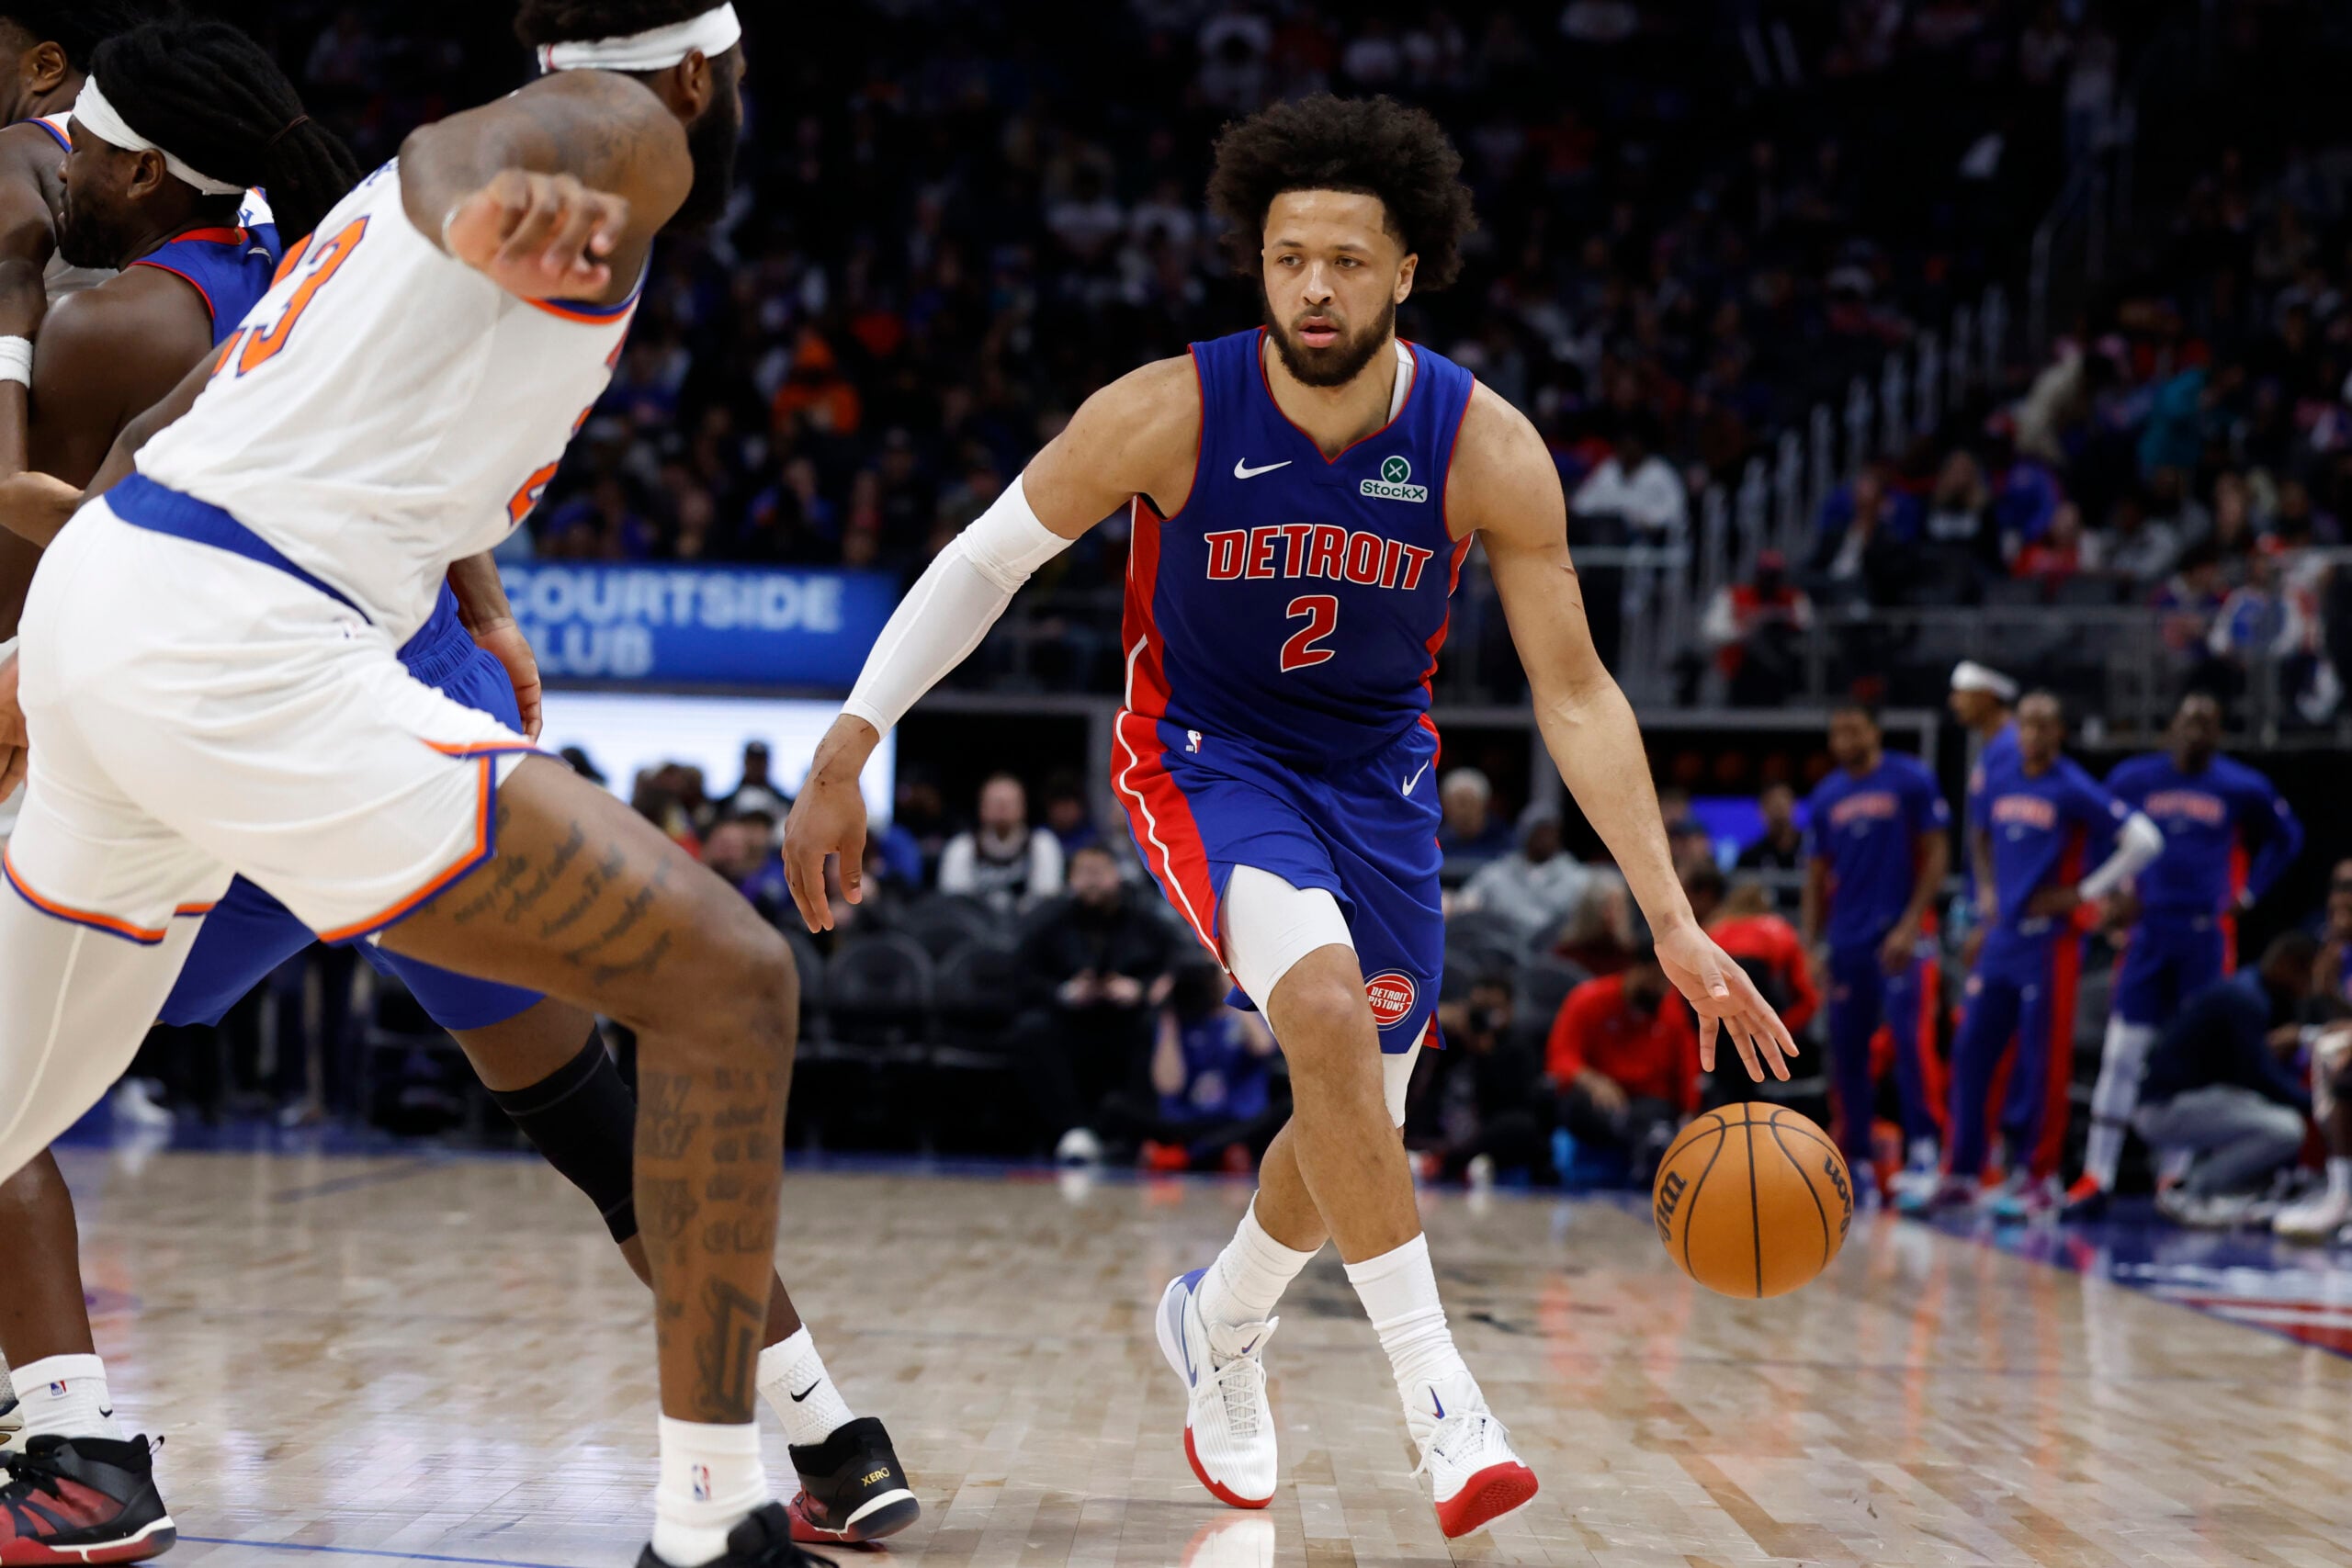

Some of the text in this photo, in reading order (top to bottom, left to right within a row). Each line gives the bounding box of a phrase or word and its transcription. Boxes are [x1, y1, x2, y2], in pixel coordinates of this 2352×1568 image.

[1363, 481, 1425, 501] StockX
[1204, 524, 1433, 590] DETROIT
[1280, 595, 1339, 672] 2
[524, 623, 654, 677] LUB
[1368, 995, 1406, 1012] PISTONS
[1371, 986, 1408, 1002] DETROIT
[861, 1467, 890, 1487] XERO
